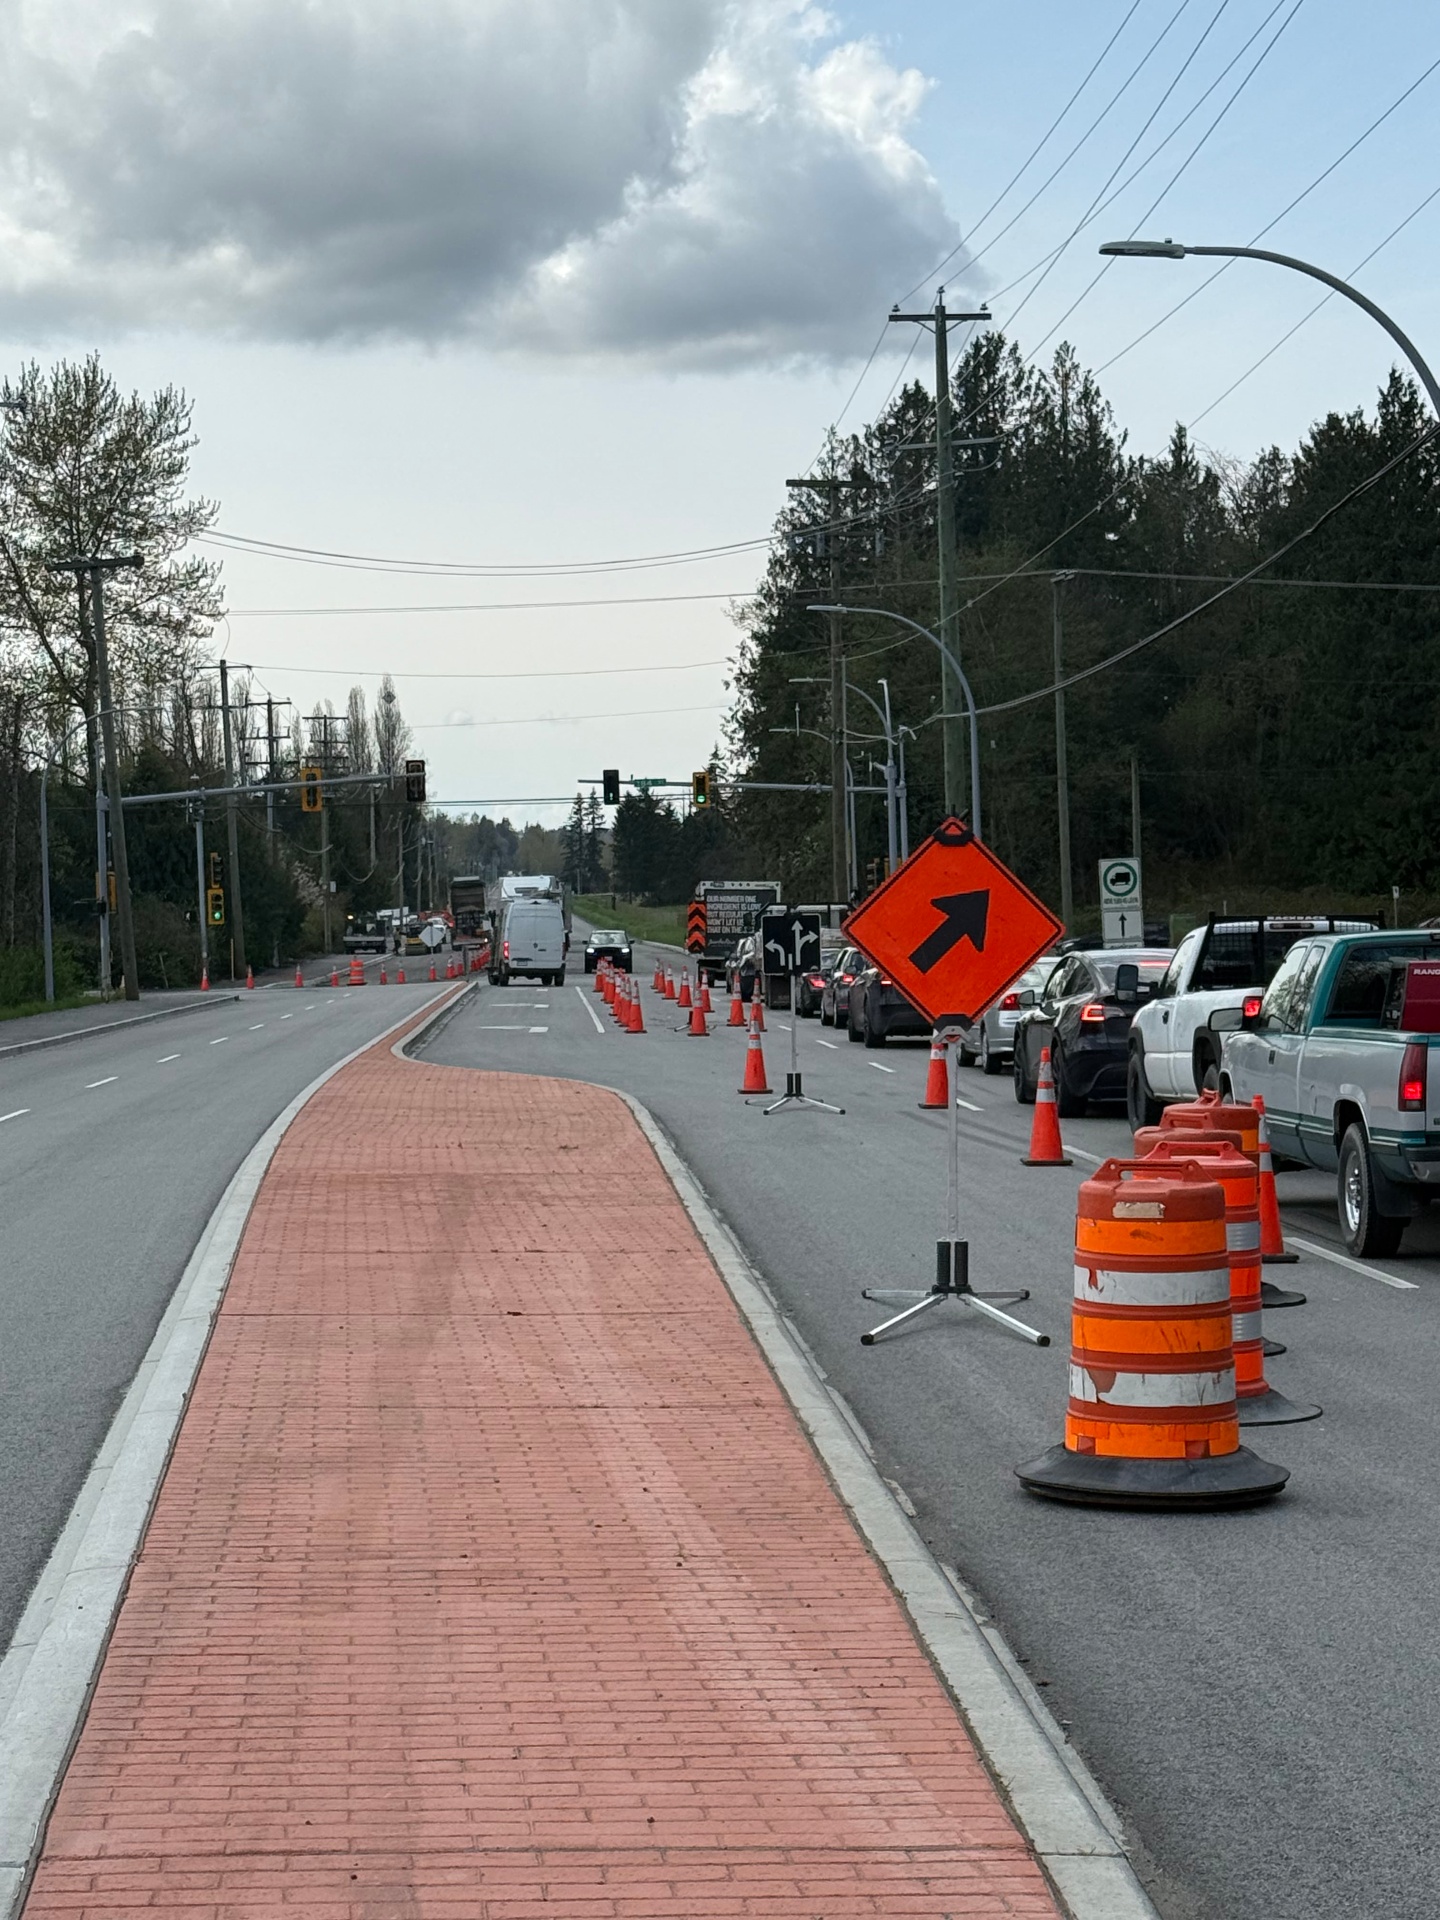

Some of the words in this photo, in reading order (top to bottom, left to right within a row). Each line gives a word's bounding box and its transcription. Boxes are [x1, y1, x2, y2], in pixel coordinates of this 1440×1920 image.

[706, 895, 719, 903] OUR
[719, 895, 744, 903] NUMBER
[744, 895, 757, 903] ONE
[706, 903, 740, 911] INGREDIENT
[740, 903, 747, 911] IS
[725, 918, 736, 926] LET
[706, 926, 721, 934] THAT
[721, 926, 731, 934] ON
